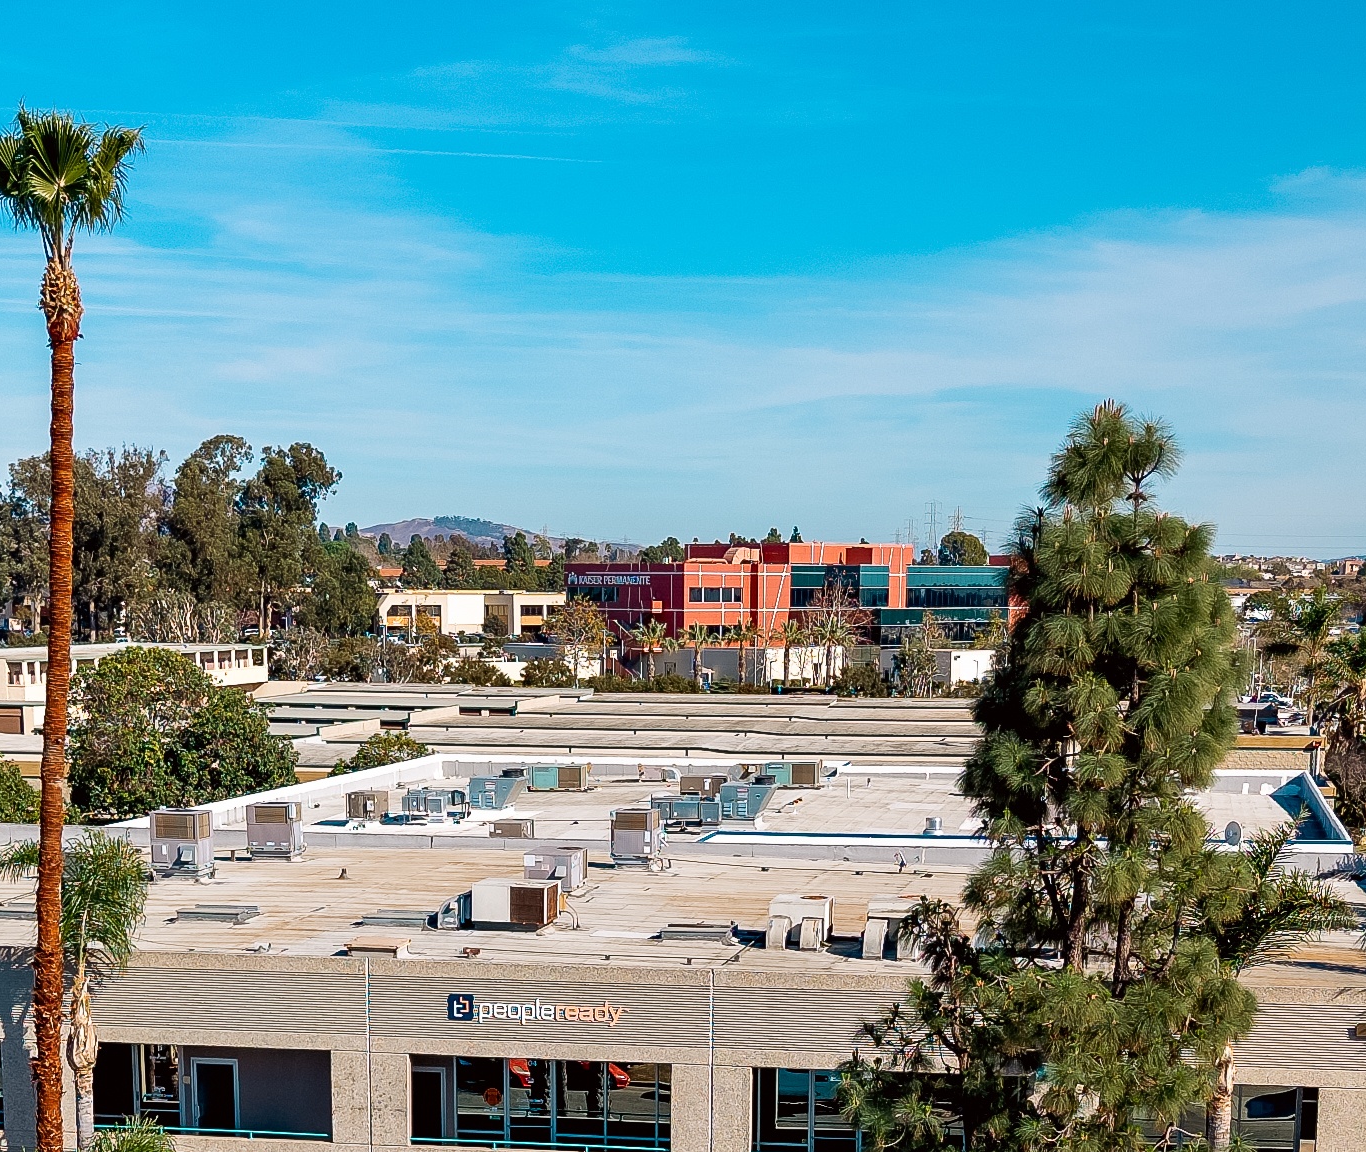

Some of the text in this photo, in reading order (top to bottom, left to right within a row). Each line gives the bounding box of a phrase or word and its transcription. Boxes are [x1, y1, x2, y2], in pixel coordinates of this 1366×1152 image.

[578, 575, 651, 585] KAISER PERMANENTE
[478, 998, 624, 1027] peopleready
